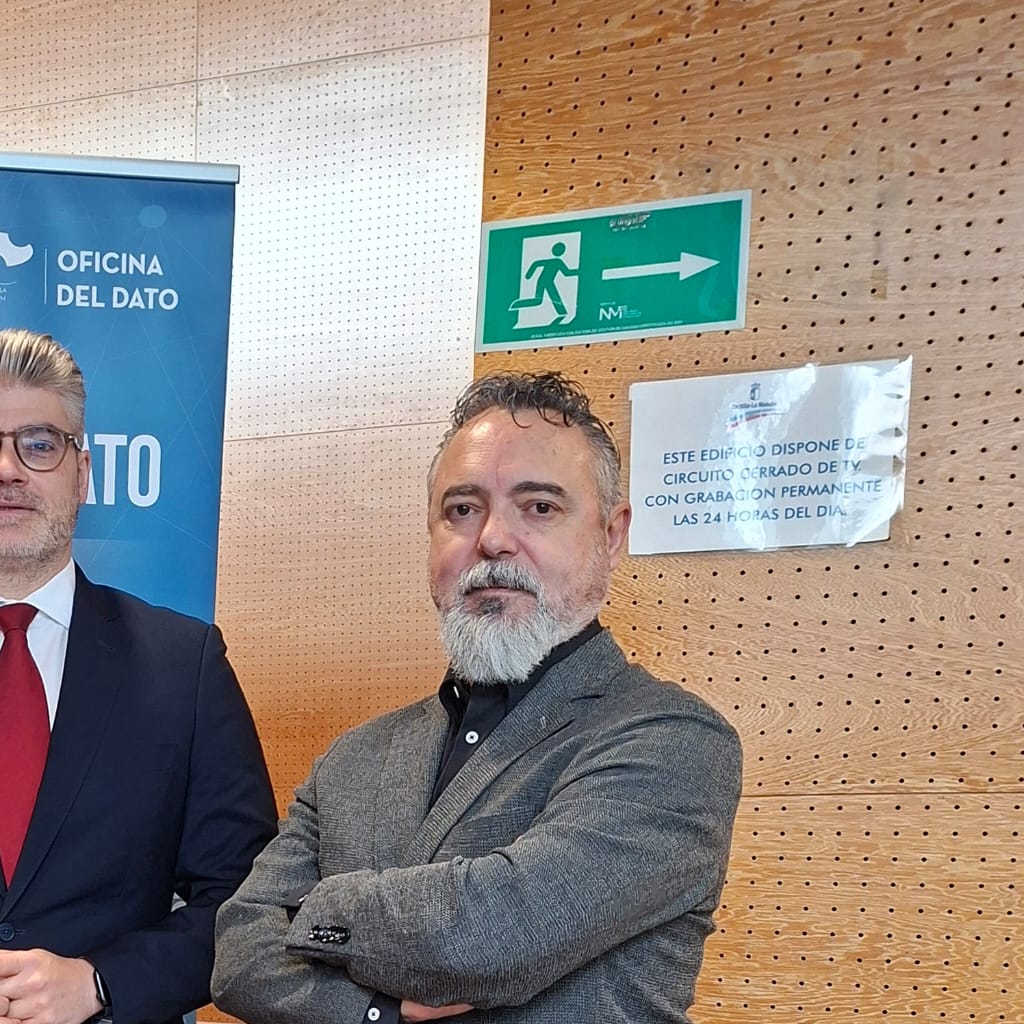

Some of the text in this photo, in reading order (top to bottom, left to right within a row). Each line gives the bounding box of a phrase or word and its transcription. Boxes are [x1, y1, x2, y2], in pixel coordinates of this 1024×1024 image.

[57, 249, 164, 276] OFICINA
[56, 284, 179, 311] DEL DATO
[663, 437, 865, 465] ESTE EDIFICIO DISPONE DE
[663, 468, 734, 486] CIRCUITO
[740, 462, 812, 481] CERRADO
[817, 460, 838, 474] DE
[644, 493, 679, 508] CON
[780, 479, 882, 499] PERMANENTE
[673, 512, 698, 526] LAS
[703, 511, 721, 524] 24
[727, 508, 779, 523] HORAS
[784, 506, 812, 520] DEL
